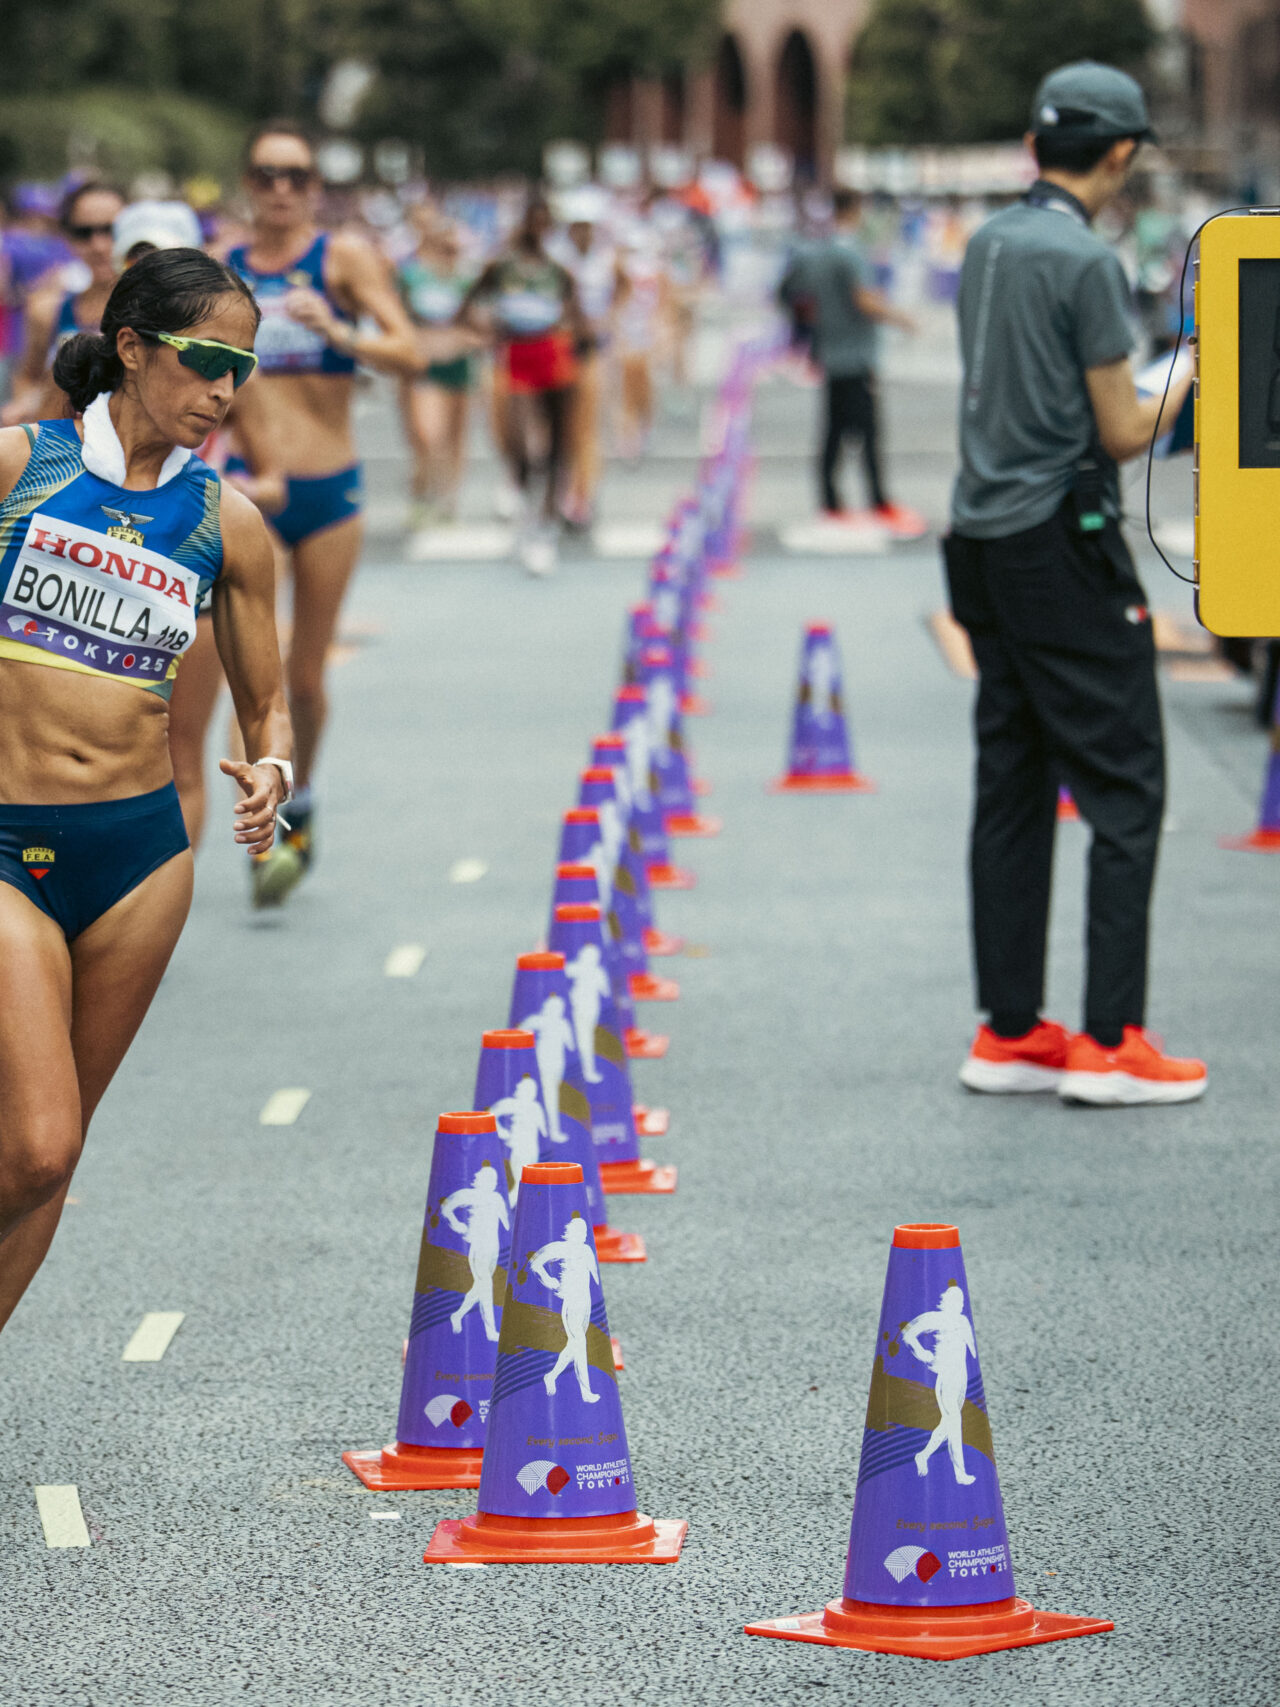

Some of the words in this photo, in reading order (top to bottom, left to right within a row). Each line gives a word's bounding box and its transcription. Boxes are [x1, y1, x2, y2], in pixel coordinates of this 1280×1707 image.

[28, 528, 191, 607] HONDA
[13, 564, 151, 642] BONILLA
[154, 625, 189, 651] 118
[576, 1463, 602, 1473] WORLD
[576, 1465, 629, 1481] CHAMPIONSHIPS
[947, 1549, 976, 1560] WORLD
[947, 1553, 1006, 1569] CHAMPIONSHIPS
